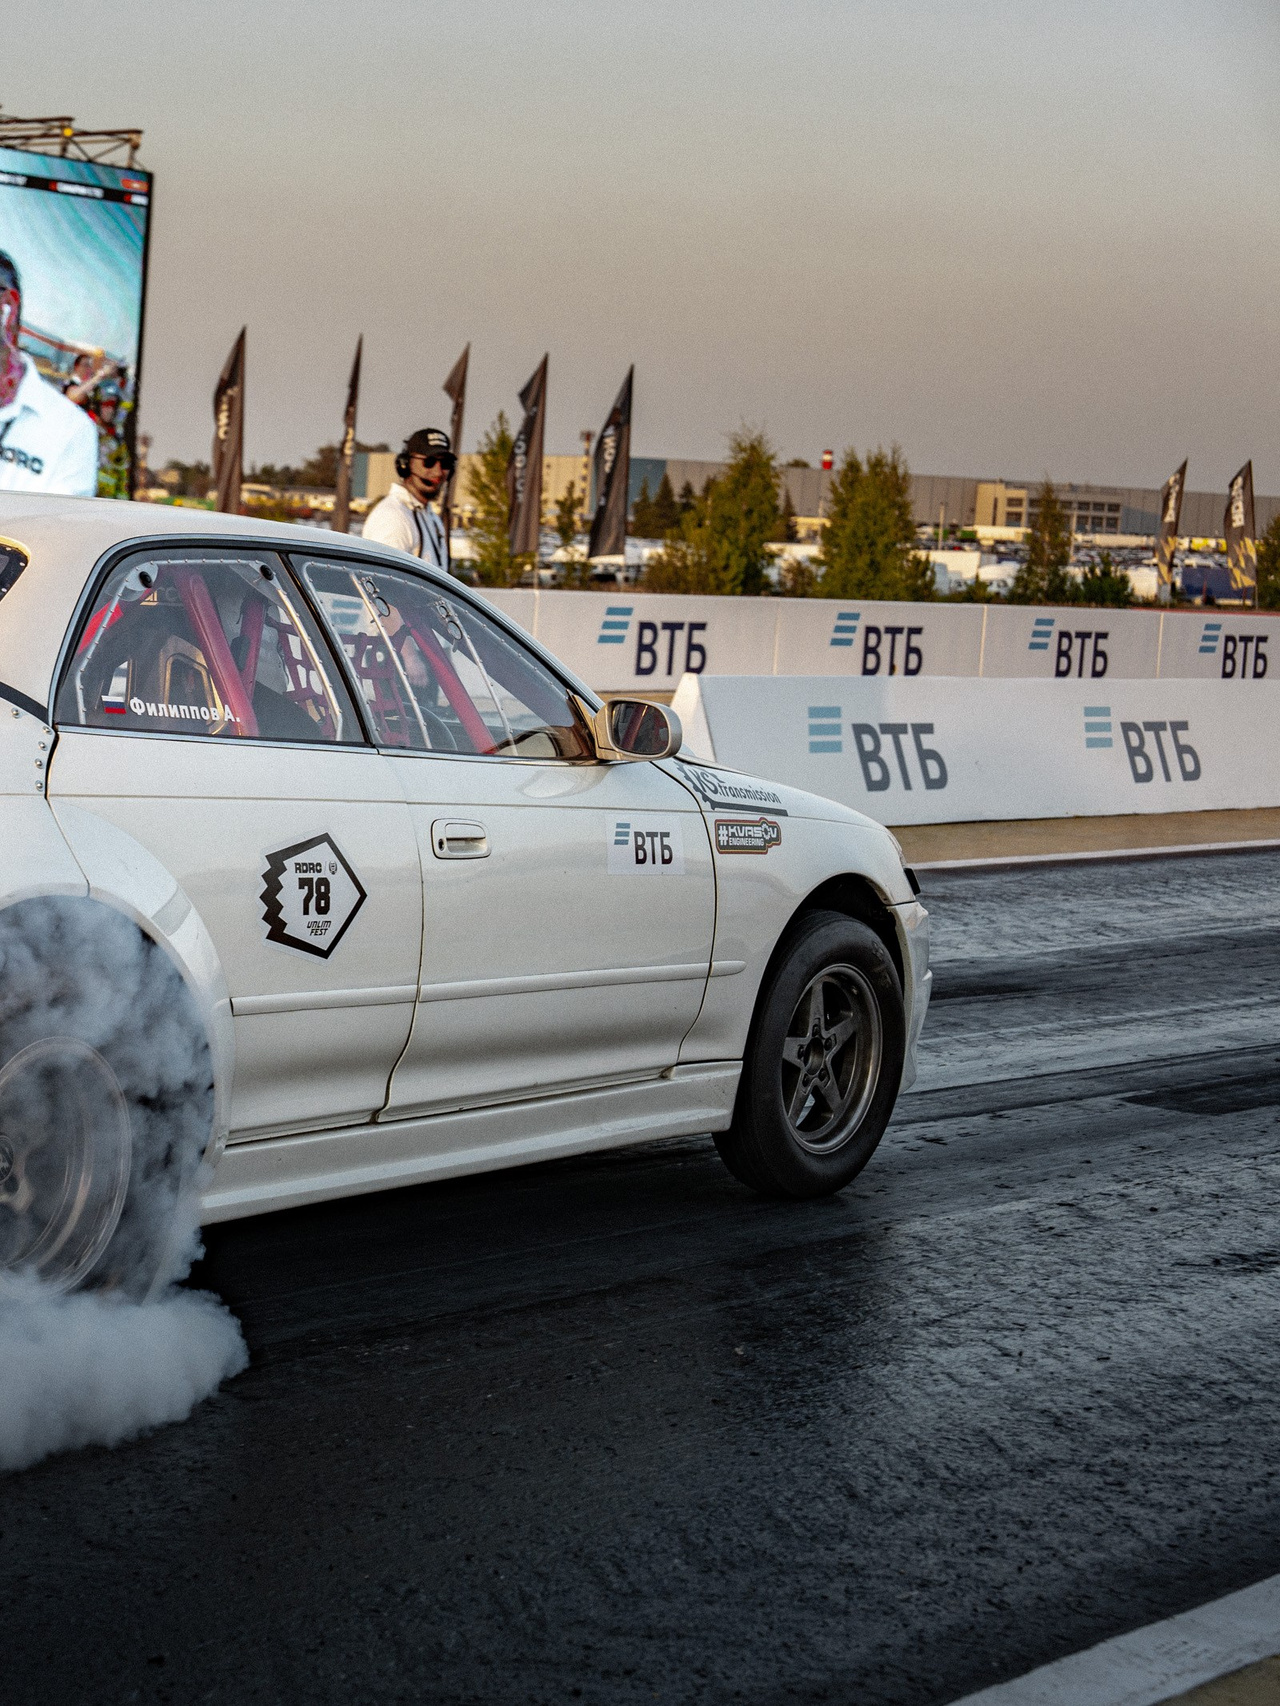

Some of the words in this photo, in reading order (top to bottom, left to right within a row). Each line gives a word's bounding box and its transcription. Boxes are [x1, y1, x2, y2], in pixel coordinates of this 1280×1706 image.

[635, 621, 708, 675] ВТБ
[861, 626, 924, 676] ВТБ
[1054, 631, 1109, 678] ВТБ
[1221, 635, 1269, 679] ВТБ
[129, 697, 220, 721] Филиппов
[851, 723, 948, 792] ВТБ
[1120, 720, 1202, 784] ВТБ
[633, 831, 673, 865] ВТБ
[728, 837, 765, 847] ENGINEERING
[294, 862, 323, 874] RDRC
[298, 877, 331, 915] 78
[309, 928, 329, 936] FEST
